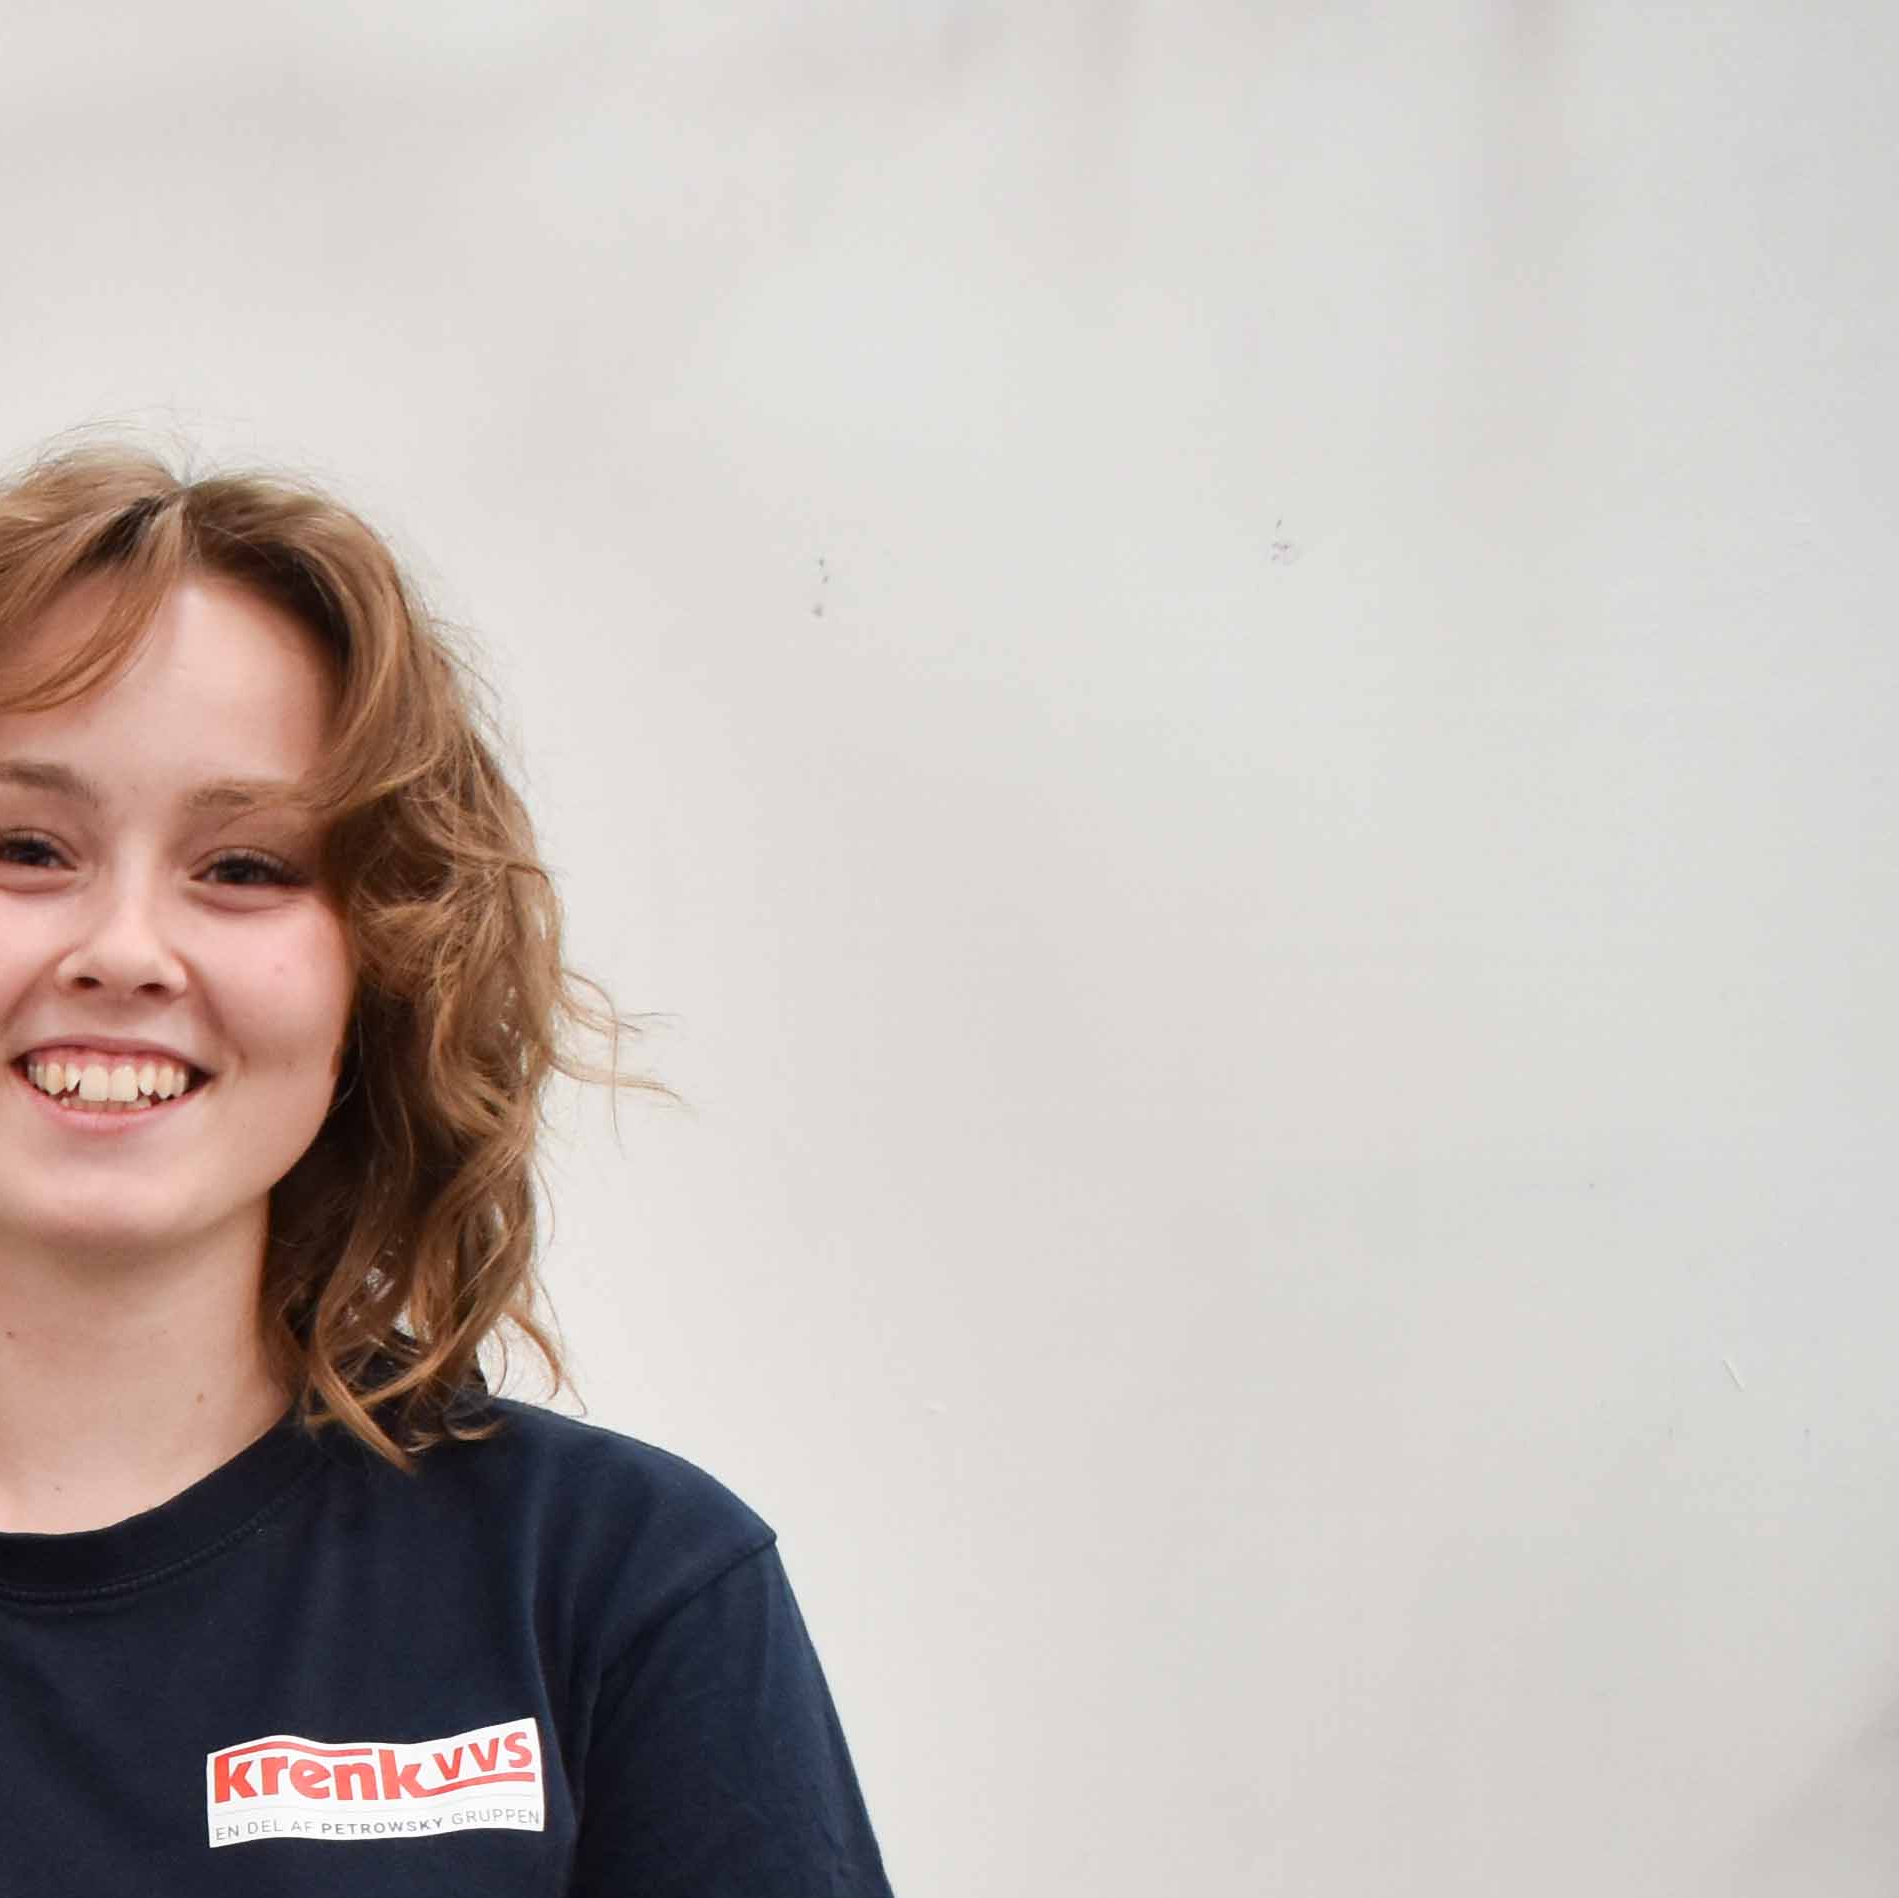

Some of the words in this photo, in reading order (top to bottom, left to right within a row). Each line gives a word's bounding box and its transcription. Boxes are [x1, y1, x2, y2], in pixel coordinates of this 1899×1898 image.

[214, 1741, 434, 1804] krenk
[215, 1825, 239, 1841] EN
[247, 1819, 283, 1835] DEL
[290, 1819, 314, 1833] AF
[321, 1816, 443, 1836] PETROWSKY
[451, 1808, 541, 1826] GRUPPEN
